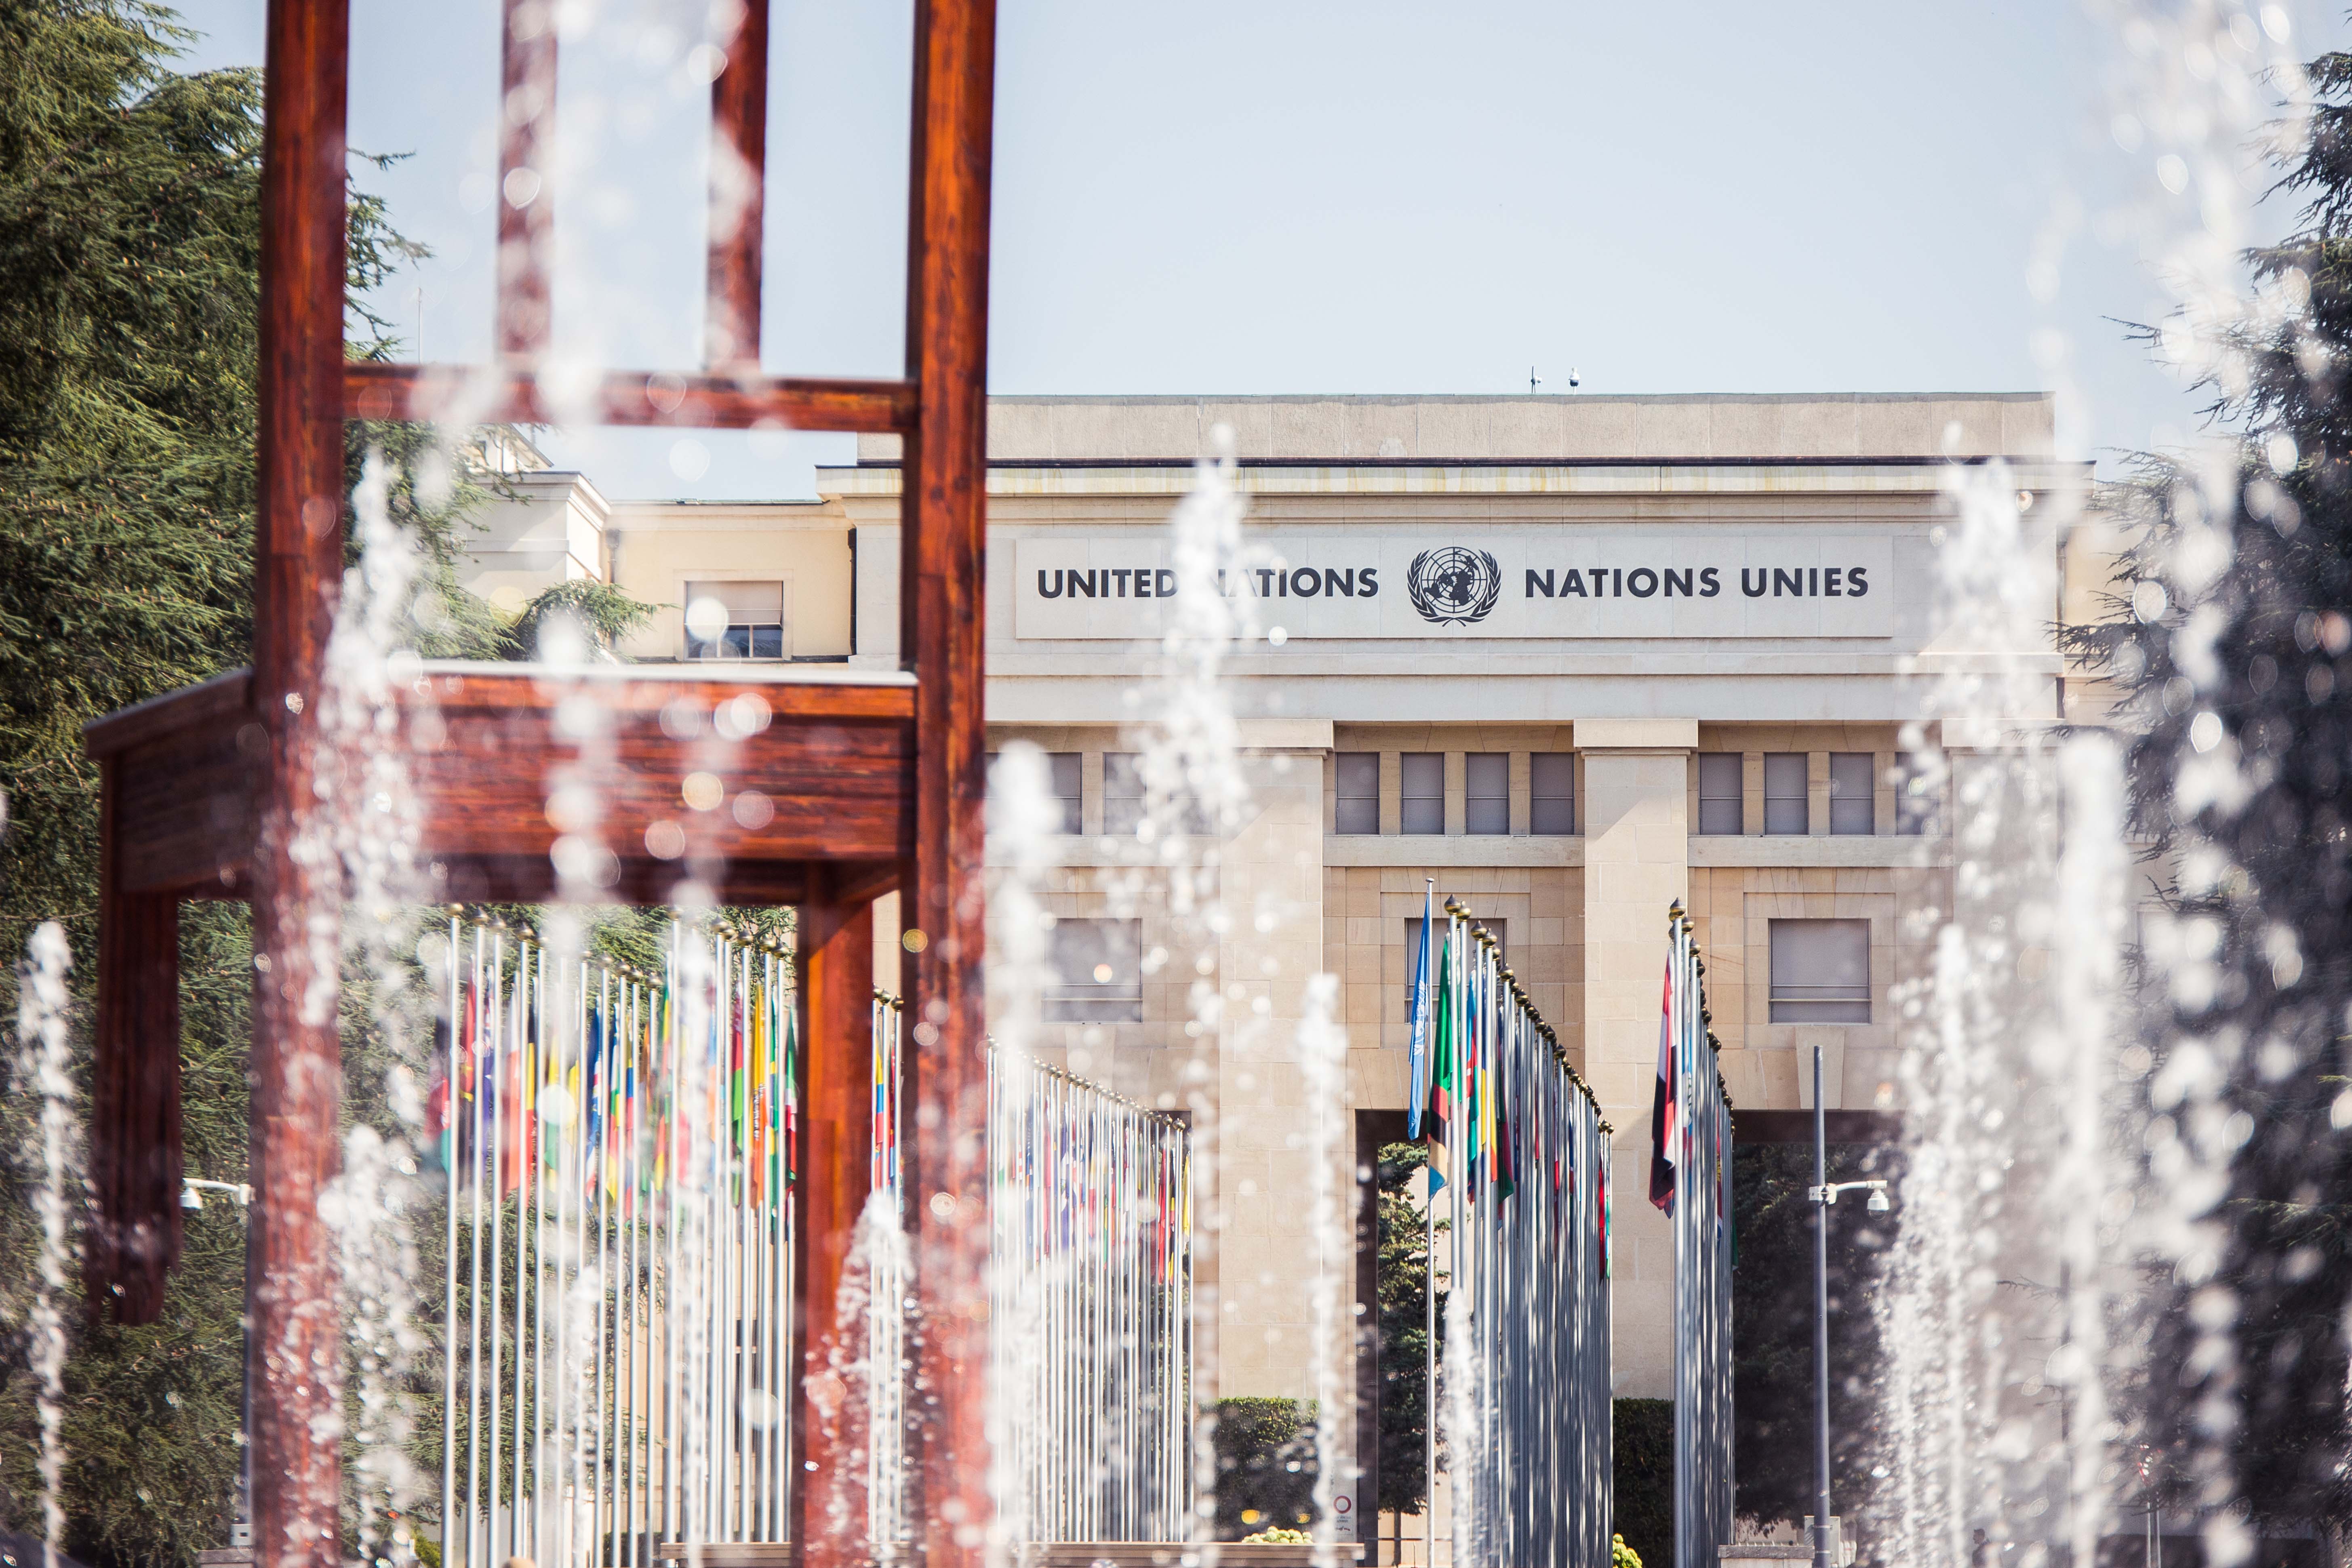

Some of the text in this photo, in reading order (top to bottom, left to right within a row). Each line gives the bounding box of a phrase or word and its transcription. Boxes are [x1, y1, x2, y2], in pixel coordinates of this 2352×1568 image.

[1038, 569, 1178, 598] UNITED
[1525, 567, 1868, 598] NATIONS UNIES
